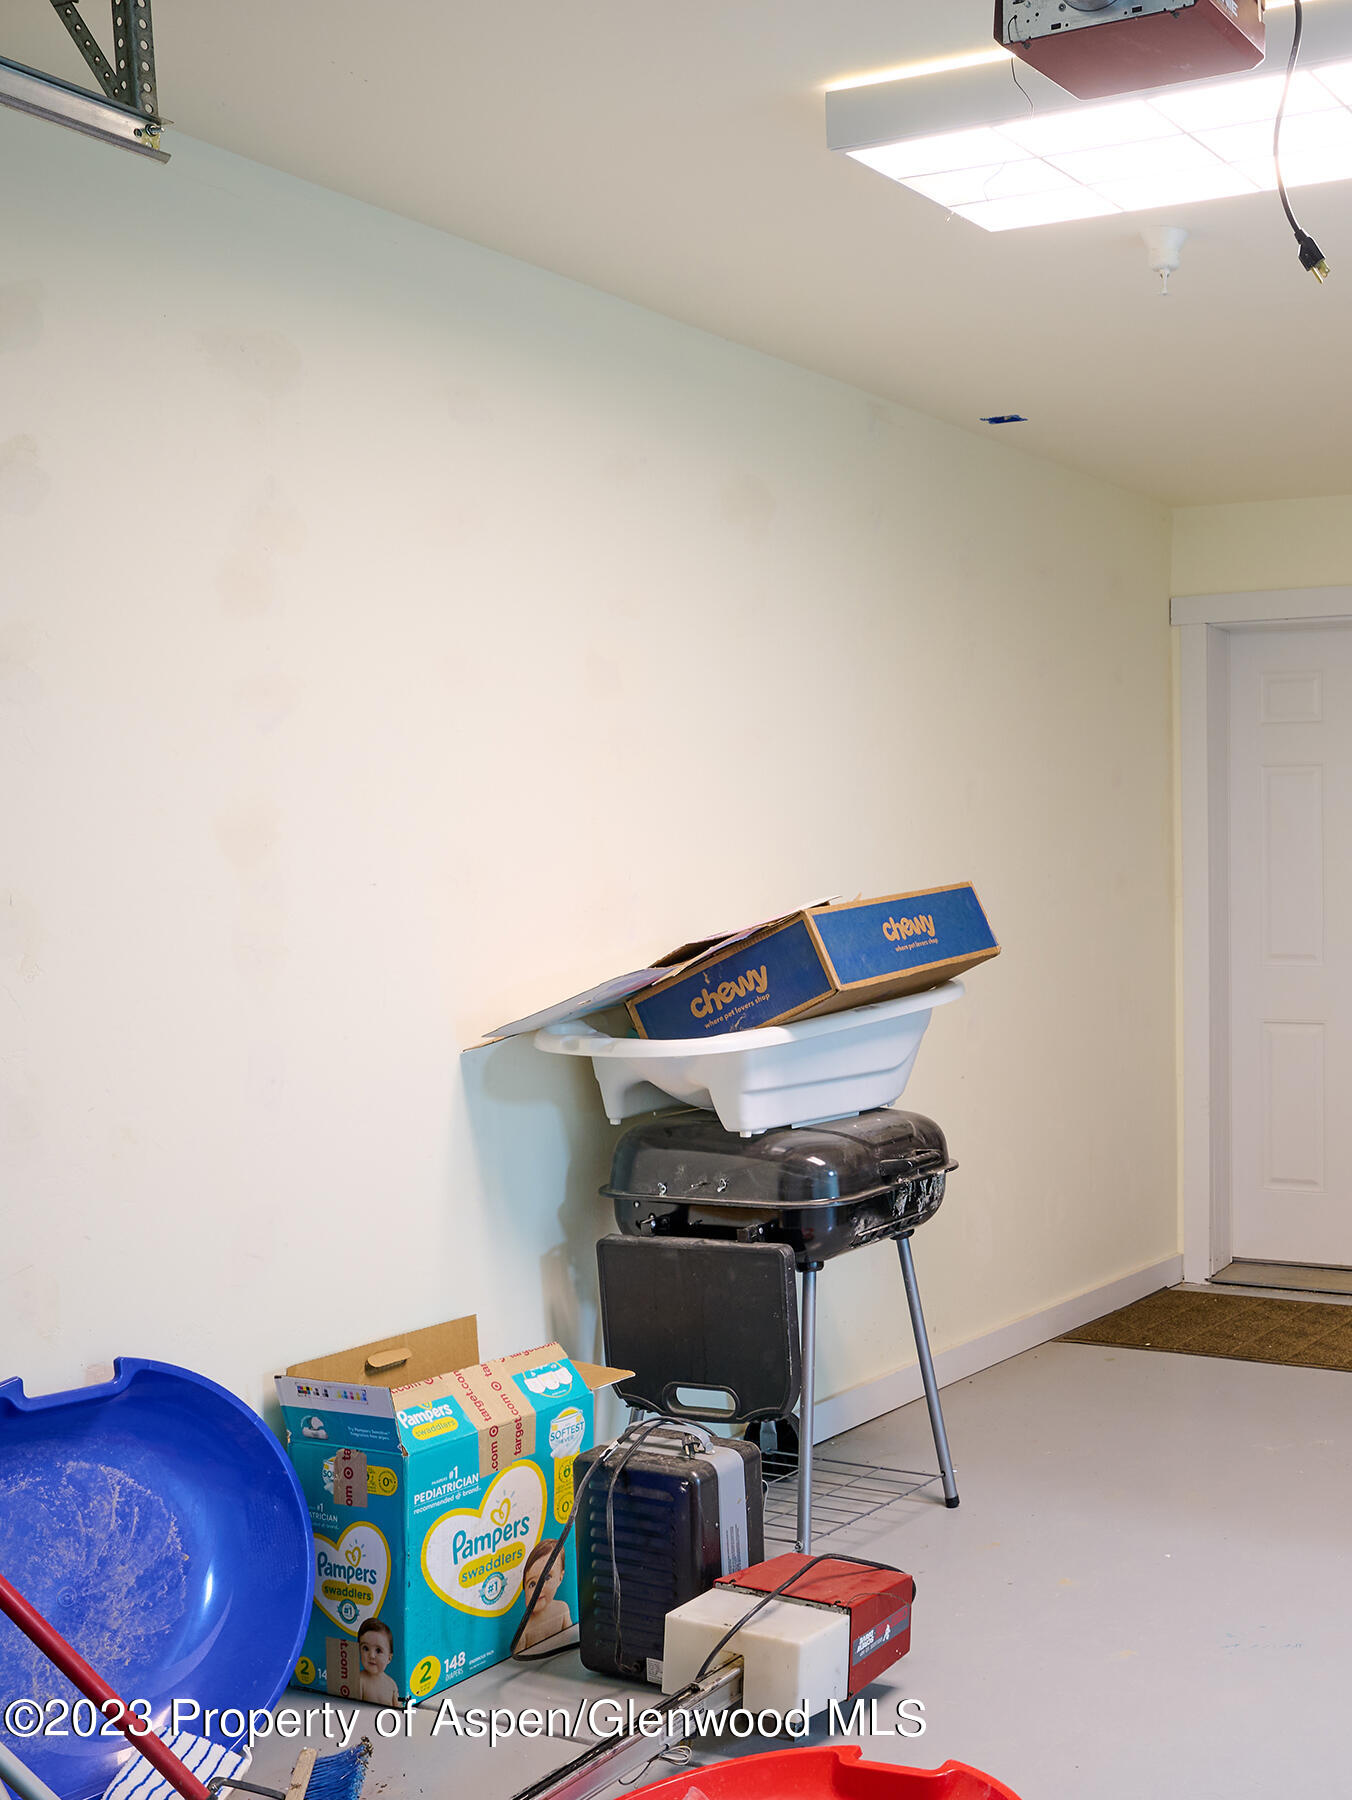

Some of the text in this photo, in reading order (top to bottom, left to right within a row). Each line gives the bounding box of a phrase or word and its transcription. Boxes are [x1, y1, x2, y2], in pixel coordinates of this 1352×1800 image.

[882, 914, 936, 941] chewy
[690, 965, 767, 1018] chewy
[704, 992, 770, 1030] where pet lovers shop
[397, 1403, 453, 1429] Pampers
[415, 1419, 456, 1437] swaddlers
[550, 1421, 585, 1442] SOFTEST
[413, 1472, 480, 1505] PEDIATRICIAN
[453, 1516, 530, 1565] Pampers
[317, 1551, 377, 1585] Pampers
[461, 1548, 523, 1583] swaddlers
[324, 1585, 372, 1601] swaddlers
[300, 1659, 310, 1676] 2
[419, 1660, 432, 1684] 2
[443, 1651, 466, 1674] 148
